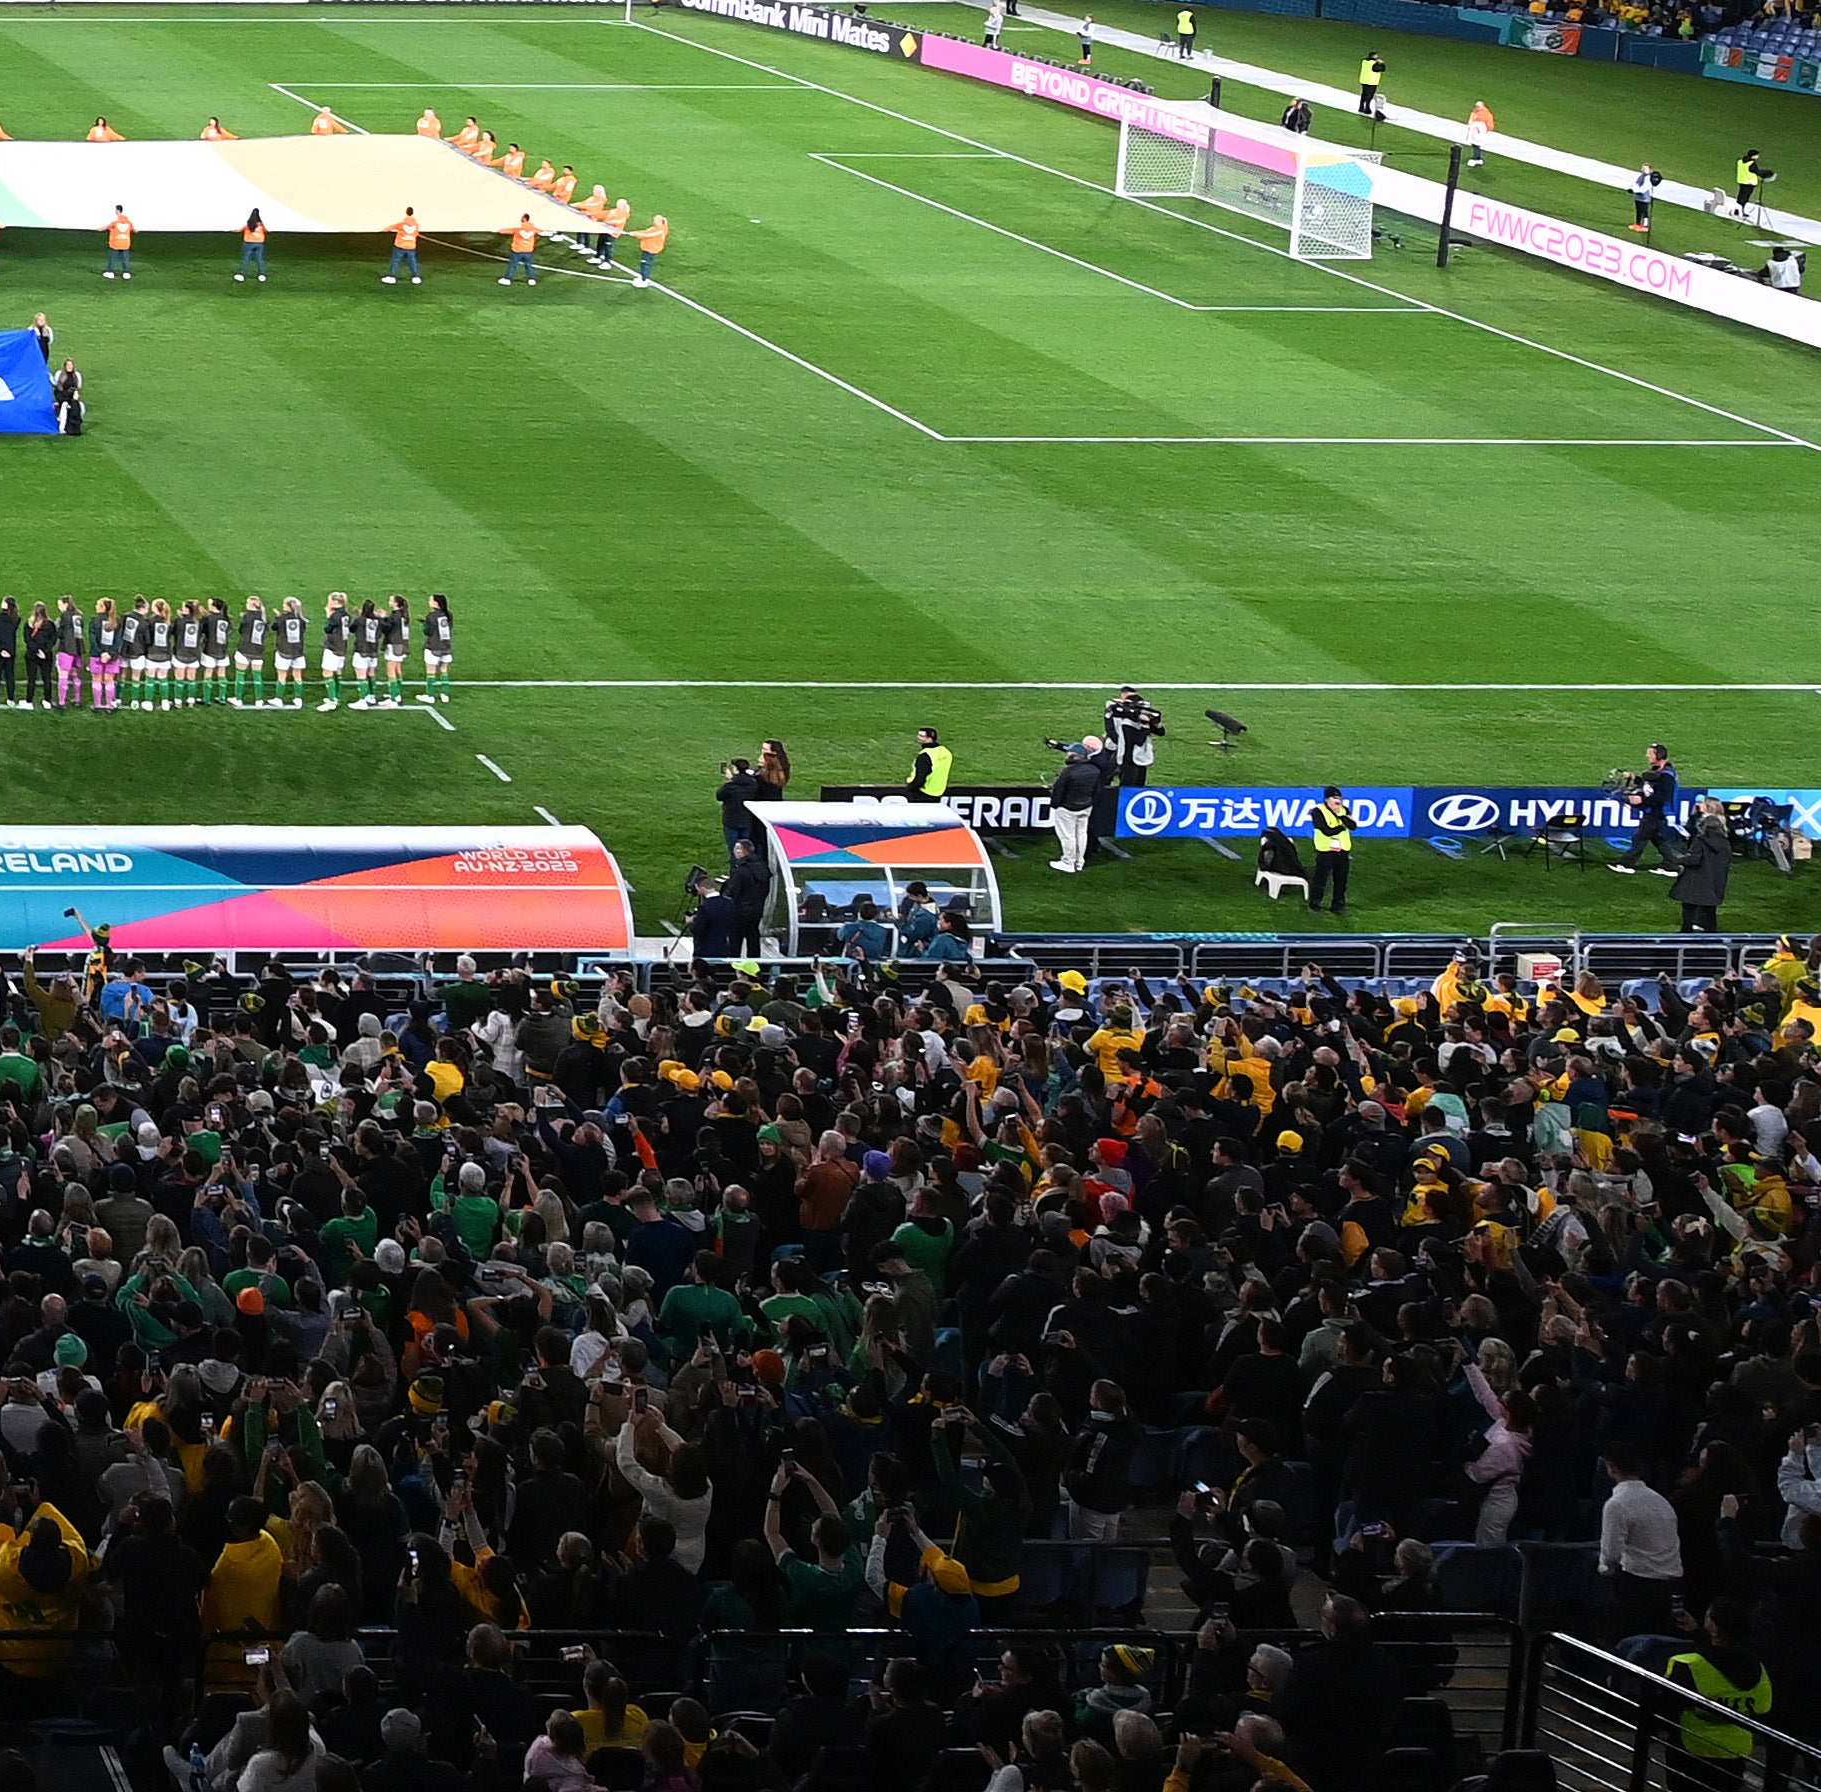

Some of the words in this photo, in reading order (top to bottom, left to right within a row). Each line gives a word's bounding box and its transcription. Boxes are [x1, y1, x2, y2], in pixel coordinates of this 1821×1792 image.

[788, 6, 828, 37] Mini
[829, 18, 890, 53] Mates
[1010, 61, 1091, 106] BEYOND
[1470, 203, 1692, 298] FWWC2023.COM
[1179, 798, 1261, 829] 万达
[458, 850, 529, 861] WORLD
[533, 850, 573, 861] CUP
